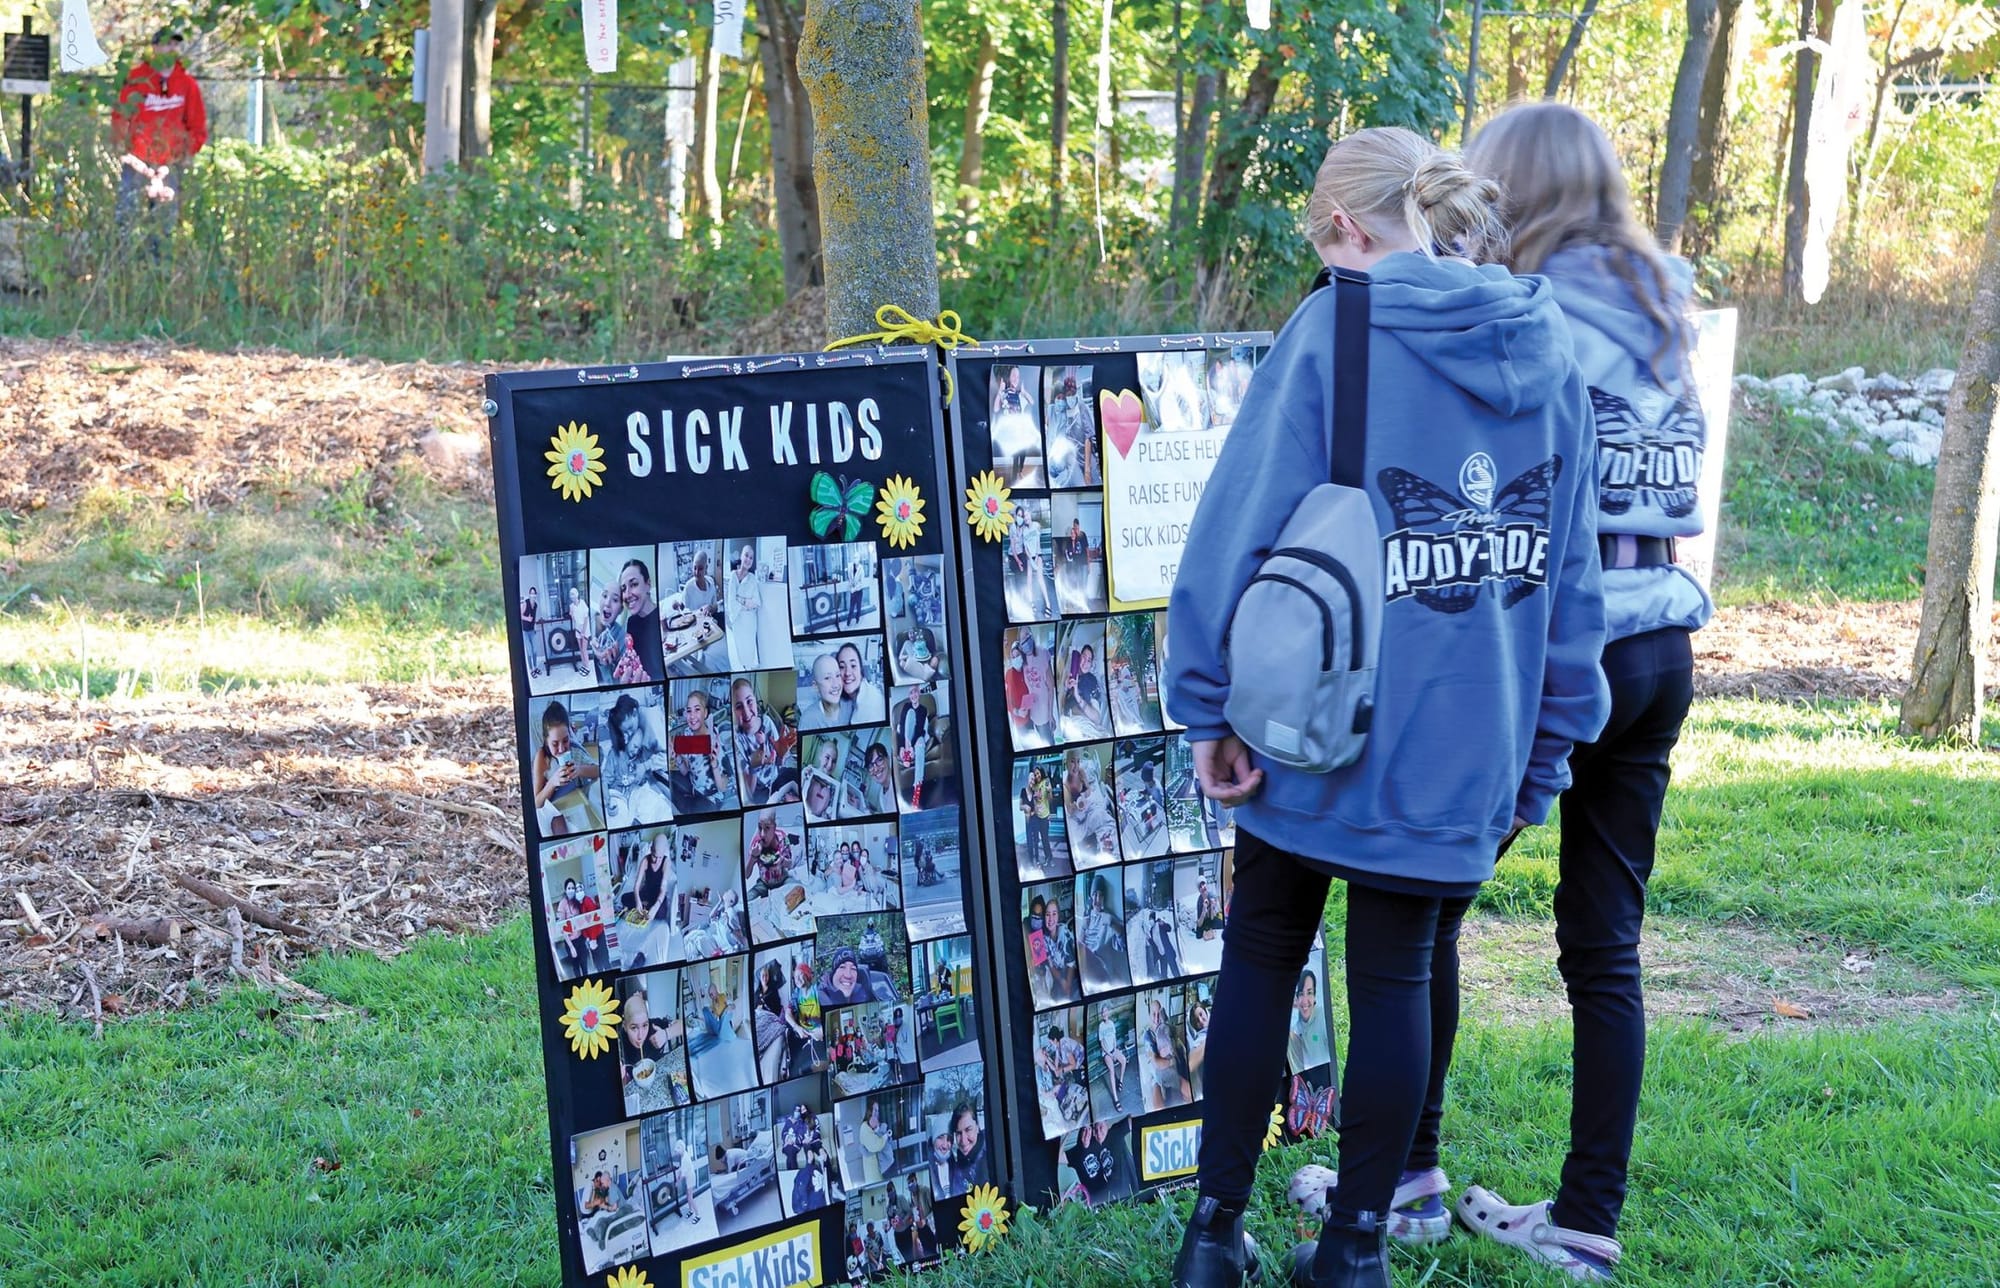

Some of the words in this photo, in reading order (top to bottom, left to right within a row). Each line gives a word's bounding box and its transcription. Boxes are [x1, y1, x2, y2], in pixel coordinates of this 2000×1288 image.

[627, 406, 750, 478] SICK
[770, 397, 883, 465] KIDS
[1138, 440, 1190, 463] PLEASE
[1129, 483, 1169, 505] RAISE
[1174, 480, 1204, 502] FUN
[1122, 525, 1153, 549] SICK
[1160, 563, 1177, 585] RE
[692, 1239, 811, 1288] SickKids
